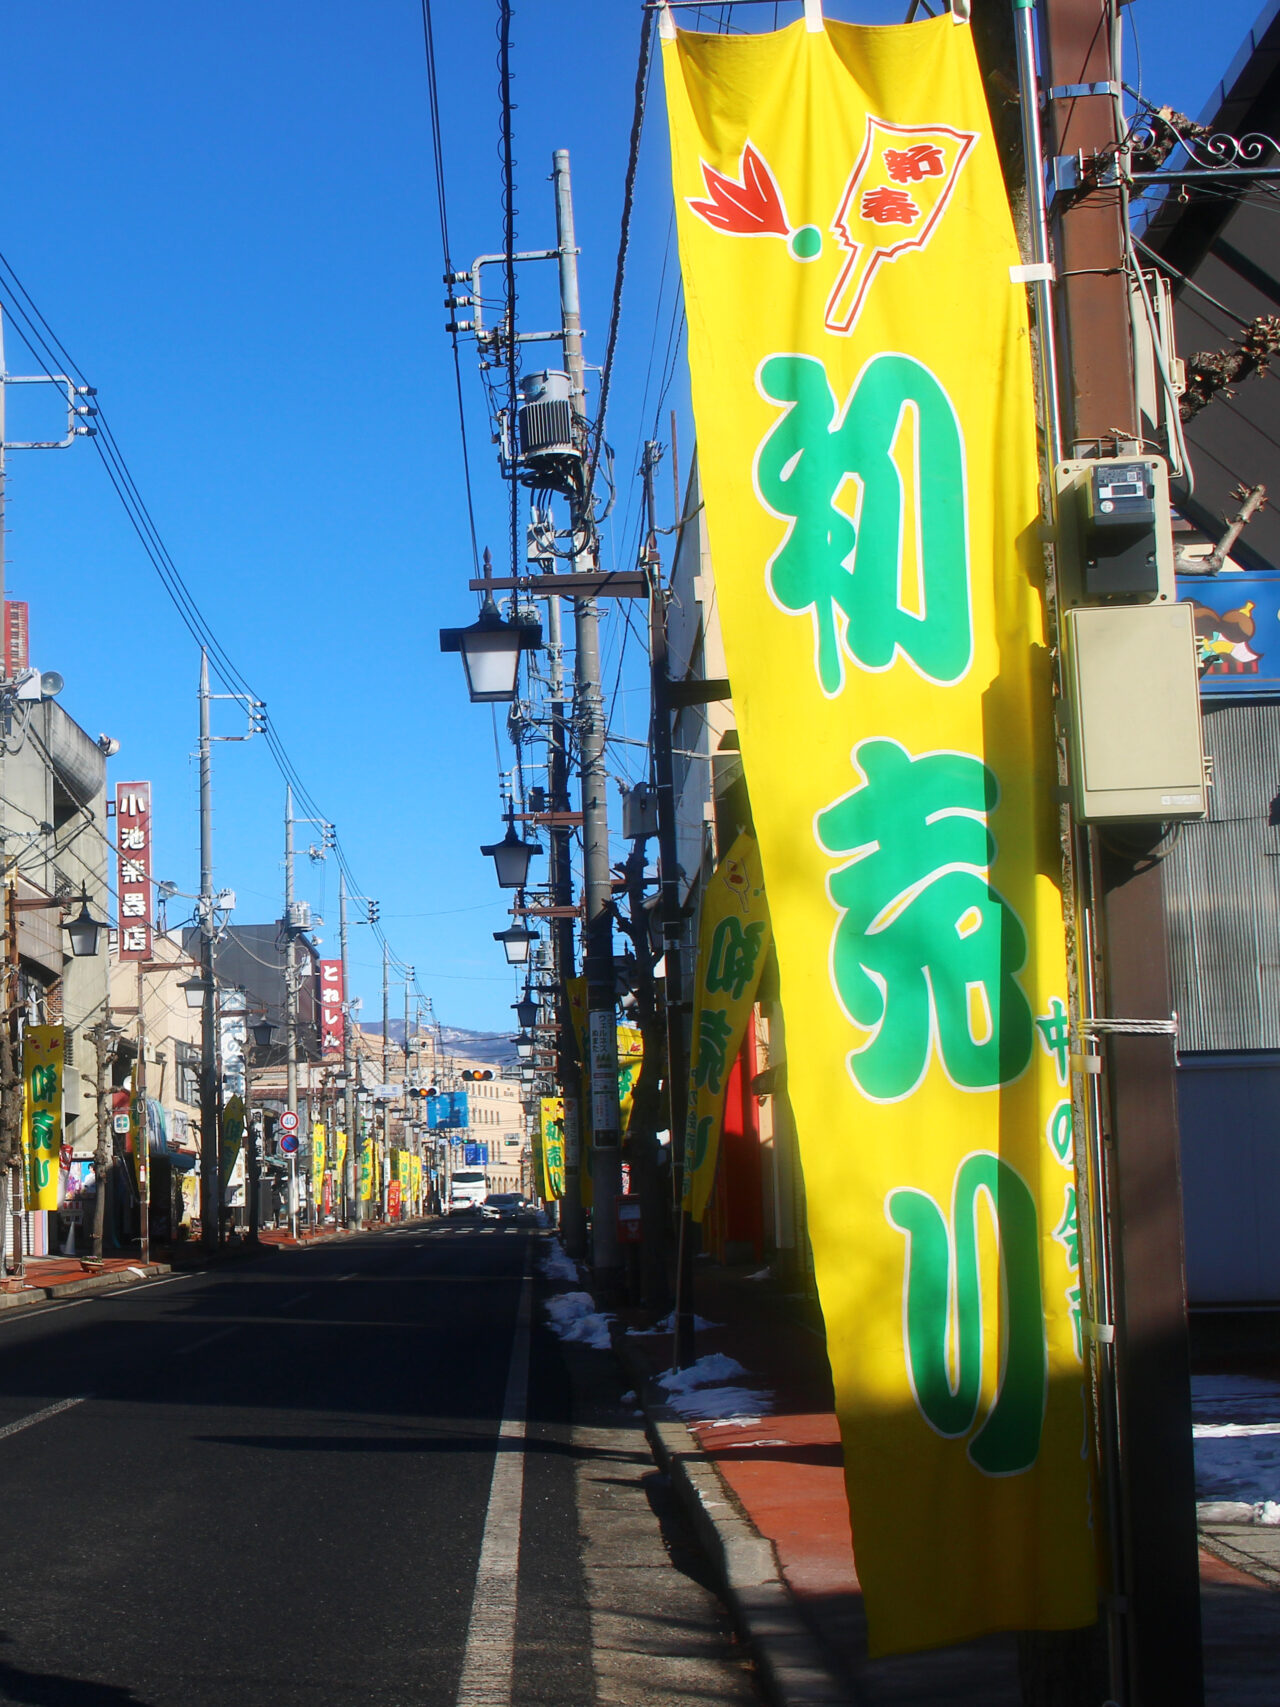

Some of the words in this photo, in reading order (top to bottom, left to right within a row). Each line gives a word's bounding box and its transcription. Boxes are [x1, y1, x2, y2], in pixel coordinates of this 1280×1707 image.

[861, 144, 944, 226] 新春
[120, 793, 146, 951] 小池楽器店
[752, 352, 1050, 1478] 初売り
[322, 965, 340, 1047] とねしん
[284, 1116, 295, 1126] 40
